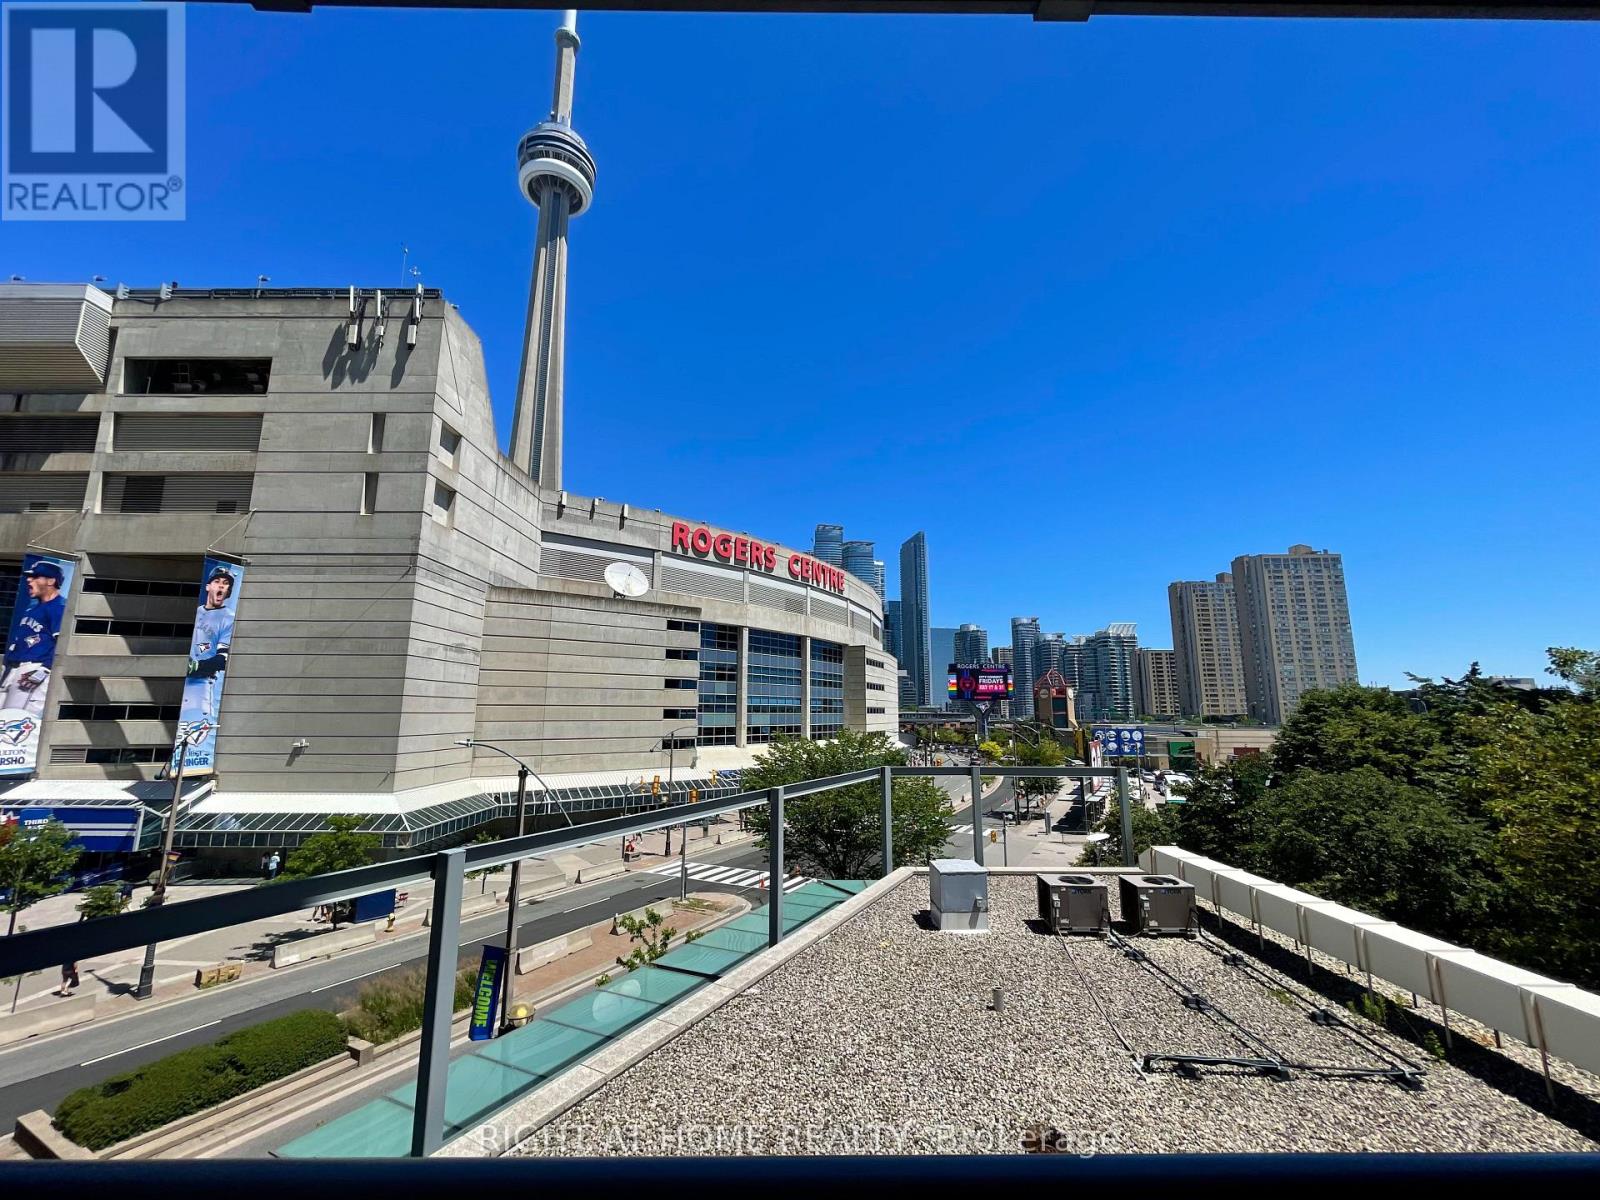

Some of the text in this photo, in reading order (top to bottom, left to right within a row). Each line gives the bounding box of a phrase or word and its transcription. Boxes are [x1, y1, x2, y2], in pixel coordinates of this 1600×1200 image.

[672, 522, 846, 593] ROGERS CENTRE
[473, 959, 498, 1027] WELCOME
